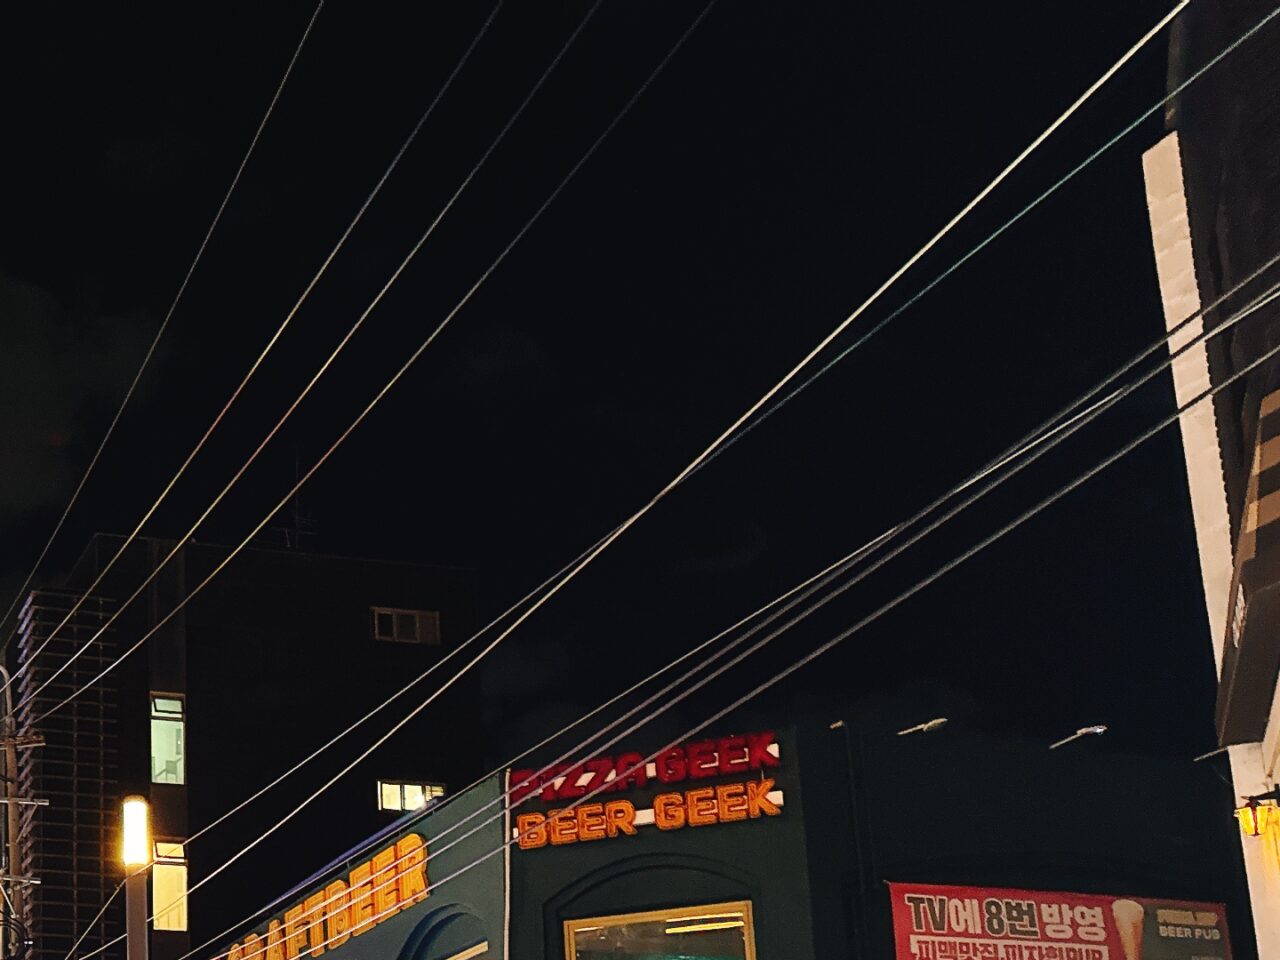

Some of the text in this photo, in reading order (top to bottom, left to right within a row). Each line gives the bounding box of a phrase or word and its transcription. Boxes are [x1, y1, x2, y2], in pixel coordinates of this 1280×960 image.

[510, 731, 779, 801] PIZZA GEEK
[516, 778, 782, 850] BEER GEEK
[906, 893, 1106, 942] TV에 8번 방영
[1159, 925, 1221, 940] BEER PUB
